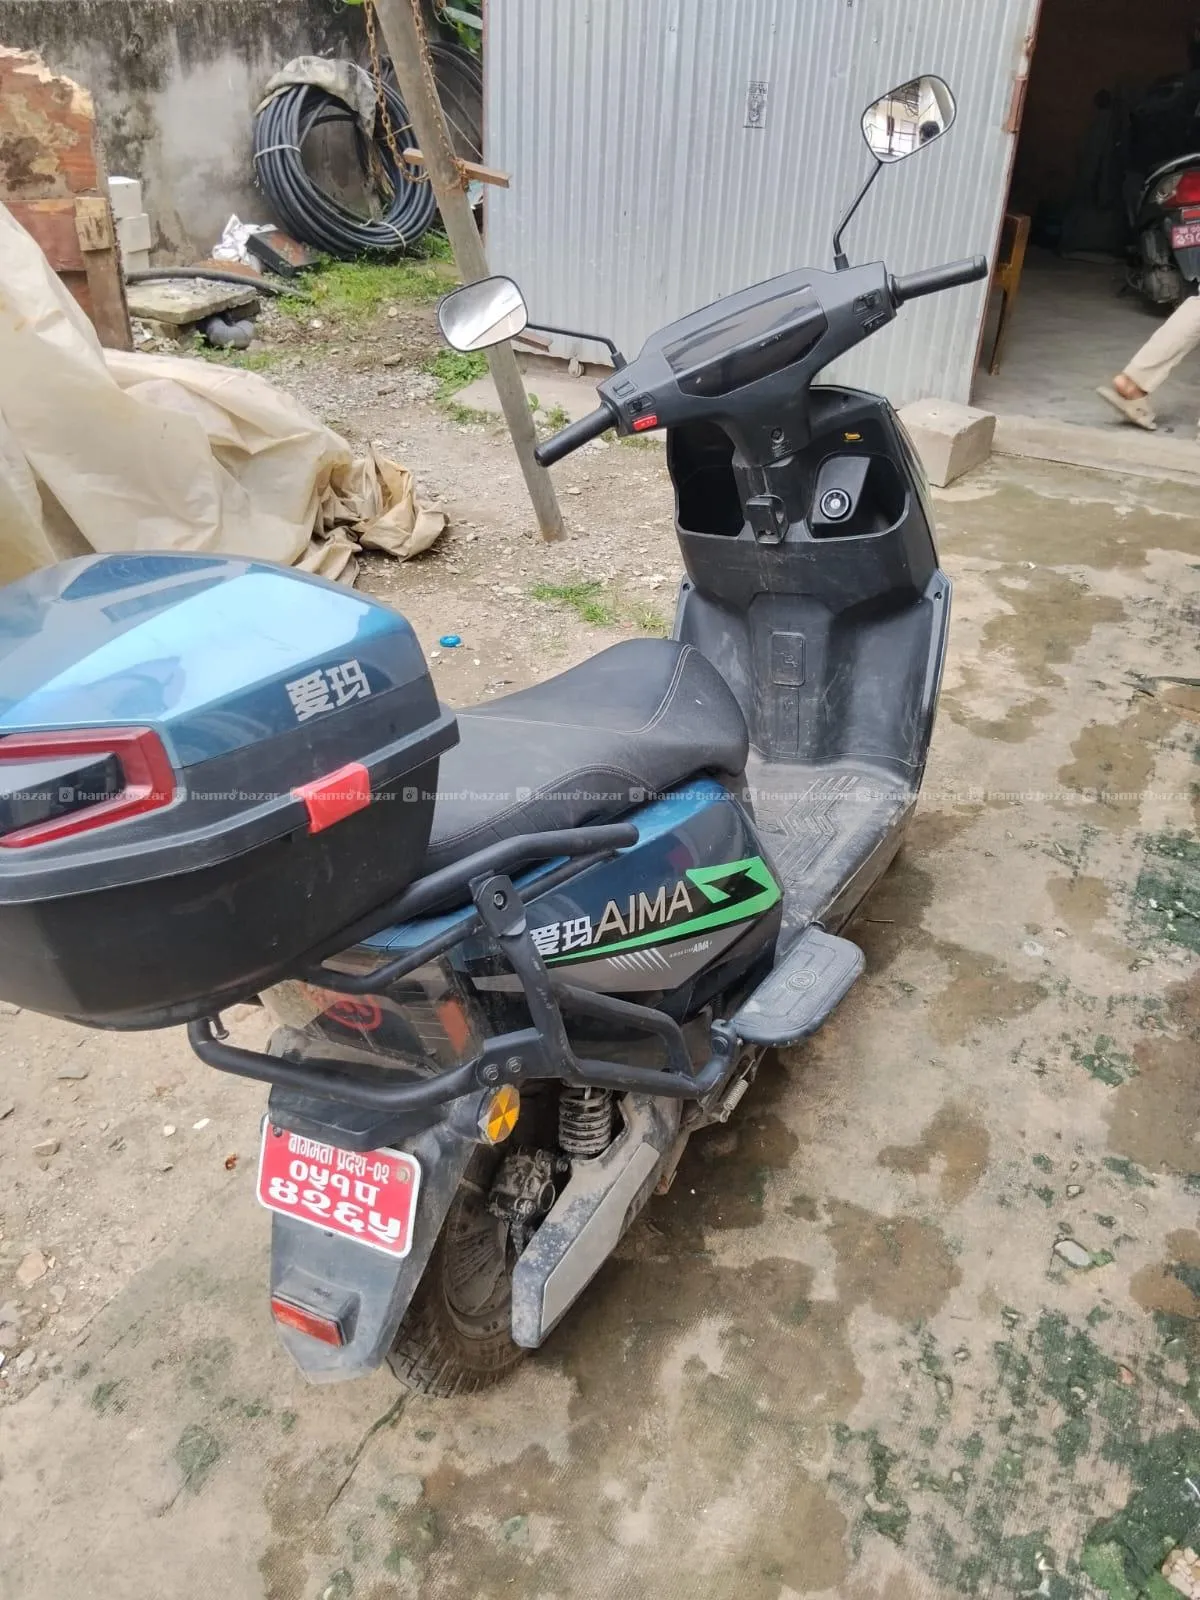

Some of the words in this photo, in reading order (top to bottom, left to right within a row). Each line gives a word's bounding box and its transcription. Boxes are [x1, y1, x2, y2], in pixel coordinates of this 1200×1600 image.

[285, 659, 371, 722] 爱玛
[529, 915, 593, 957] 爱玛
[593, 880, 694, 943] AIMA
[269, 1177, 401, 1244] ४२६५
